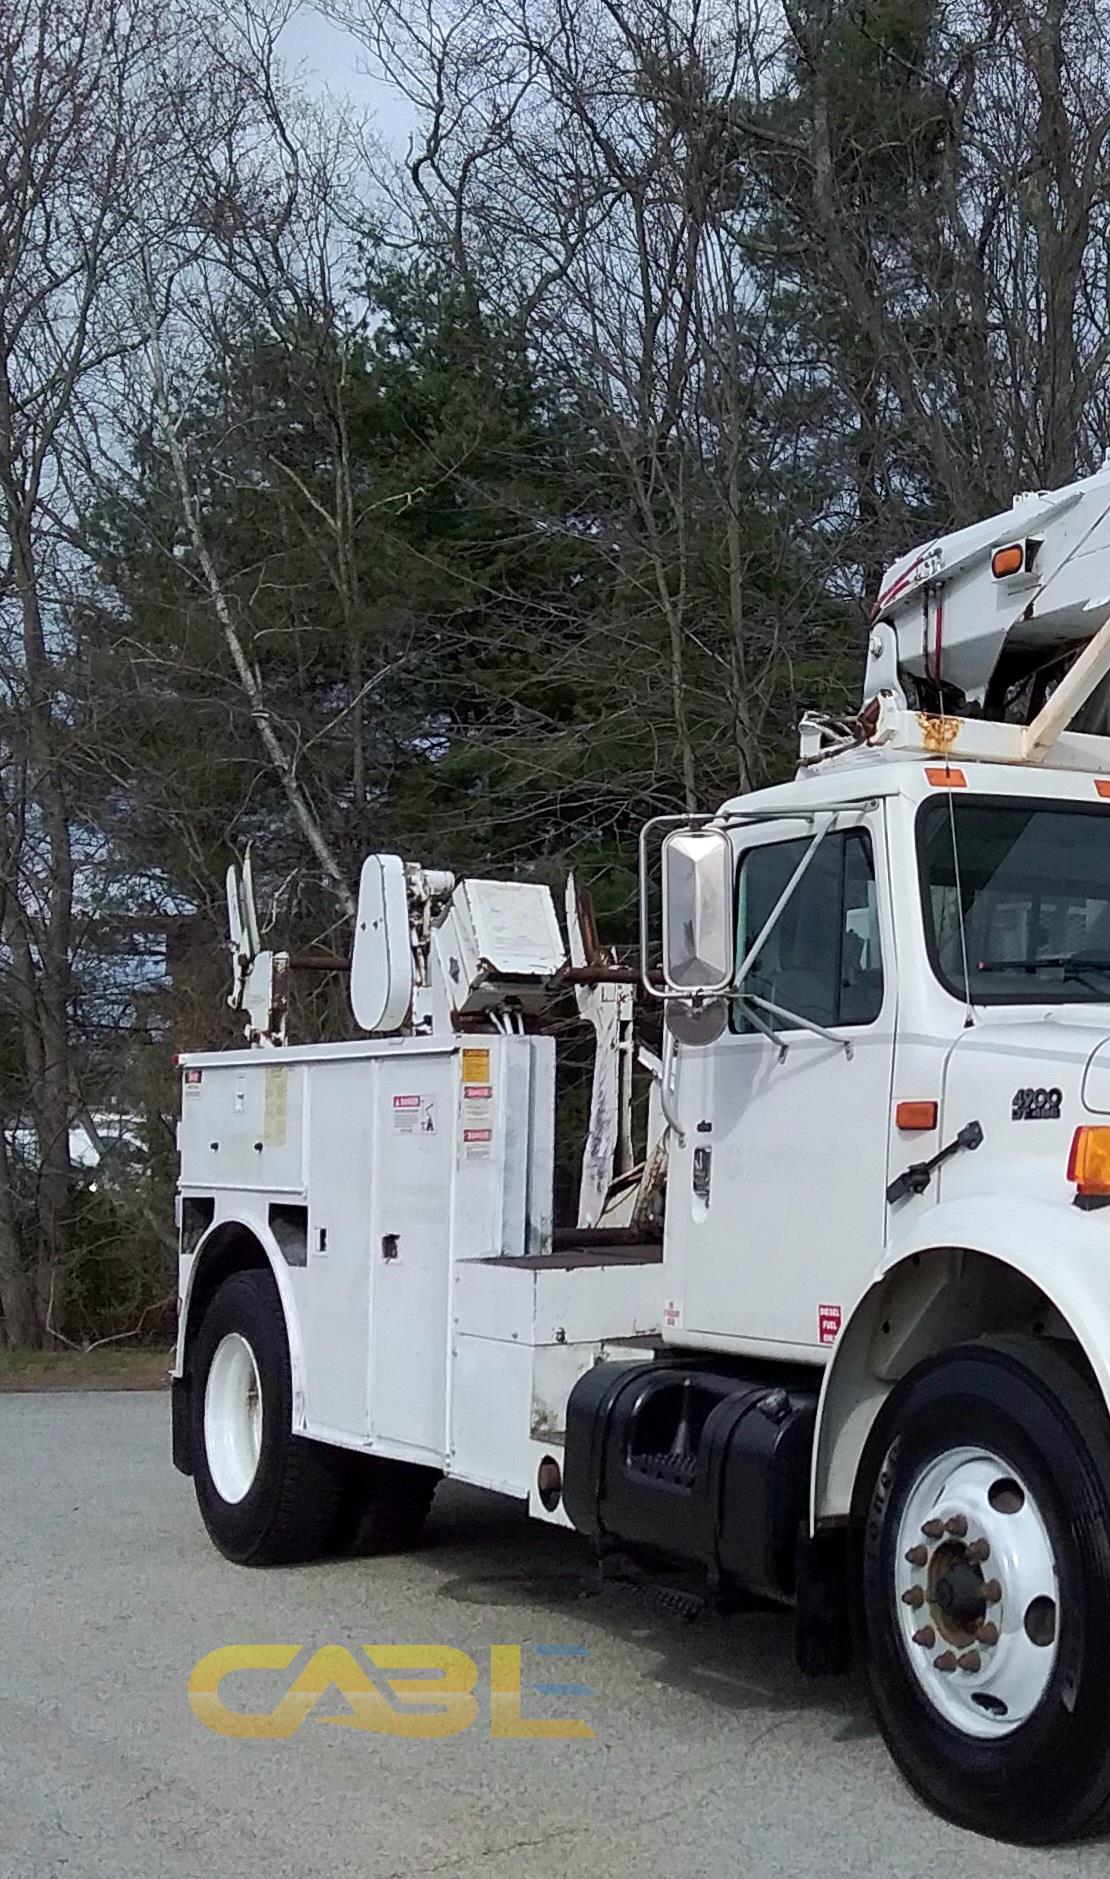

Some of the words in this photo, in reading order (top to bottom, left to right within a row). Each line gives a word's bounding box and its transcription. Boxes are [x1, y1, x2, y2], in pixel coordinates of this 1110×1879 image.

[1012, 1088, 1063, 1107] 4900
[820, 1307, 840, 1317] DIESEL
[822, 1320, 838, 1330] FUEL
